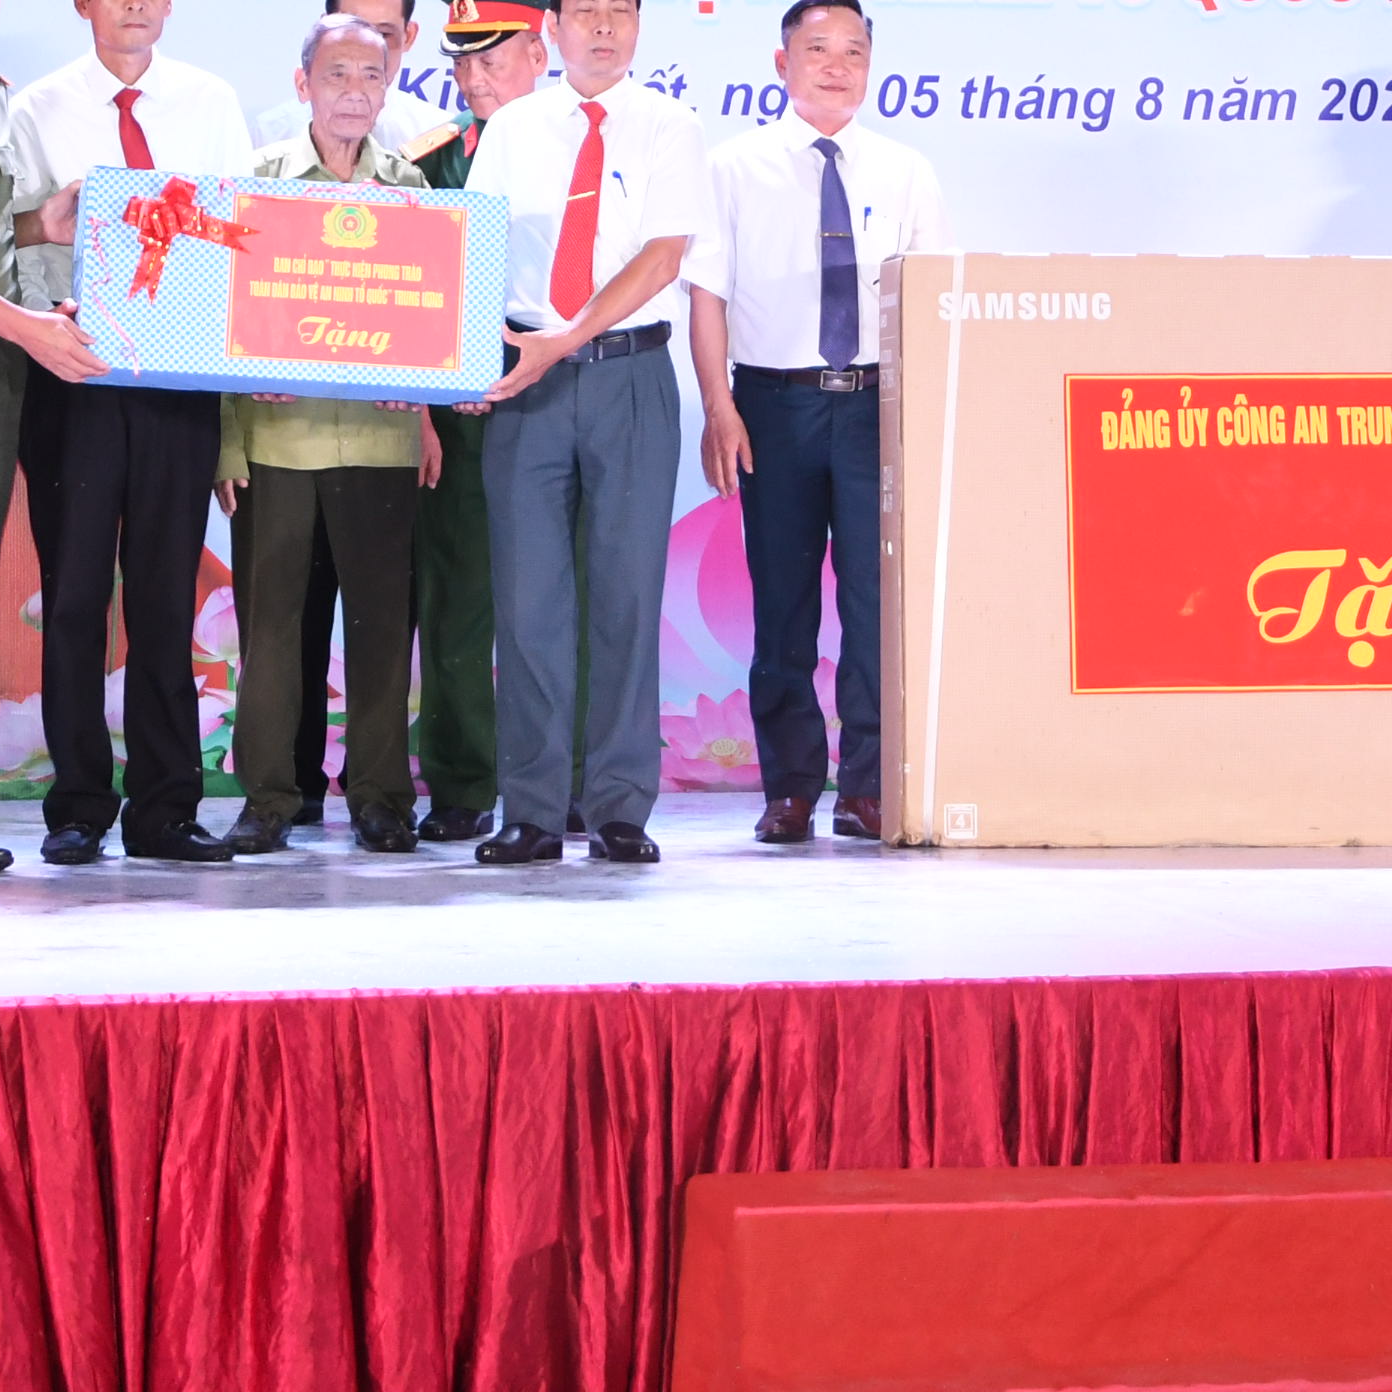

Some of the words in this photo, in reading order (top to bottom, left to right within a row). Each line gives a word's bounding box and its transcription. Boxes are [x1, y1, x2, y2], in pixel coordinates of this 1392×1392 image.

[877, 74, 940, 119] 05
[961, 74, 1115, 132] tháng
[1135, 77, 1164, 121] 8
[1183, 76, 1297, 122] năm
[938, 292, 1112, 320] SAMSUNG
[297, 315, 392, 356] Tặng
[1100, 387, 1172, 451] ĐẢNG
[1176, 385, 1210, 449] ỦY
[1216, 393, 1287, 447] CÔNG
[1292, 404, 1329, 445] AN
